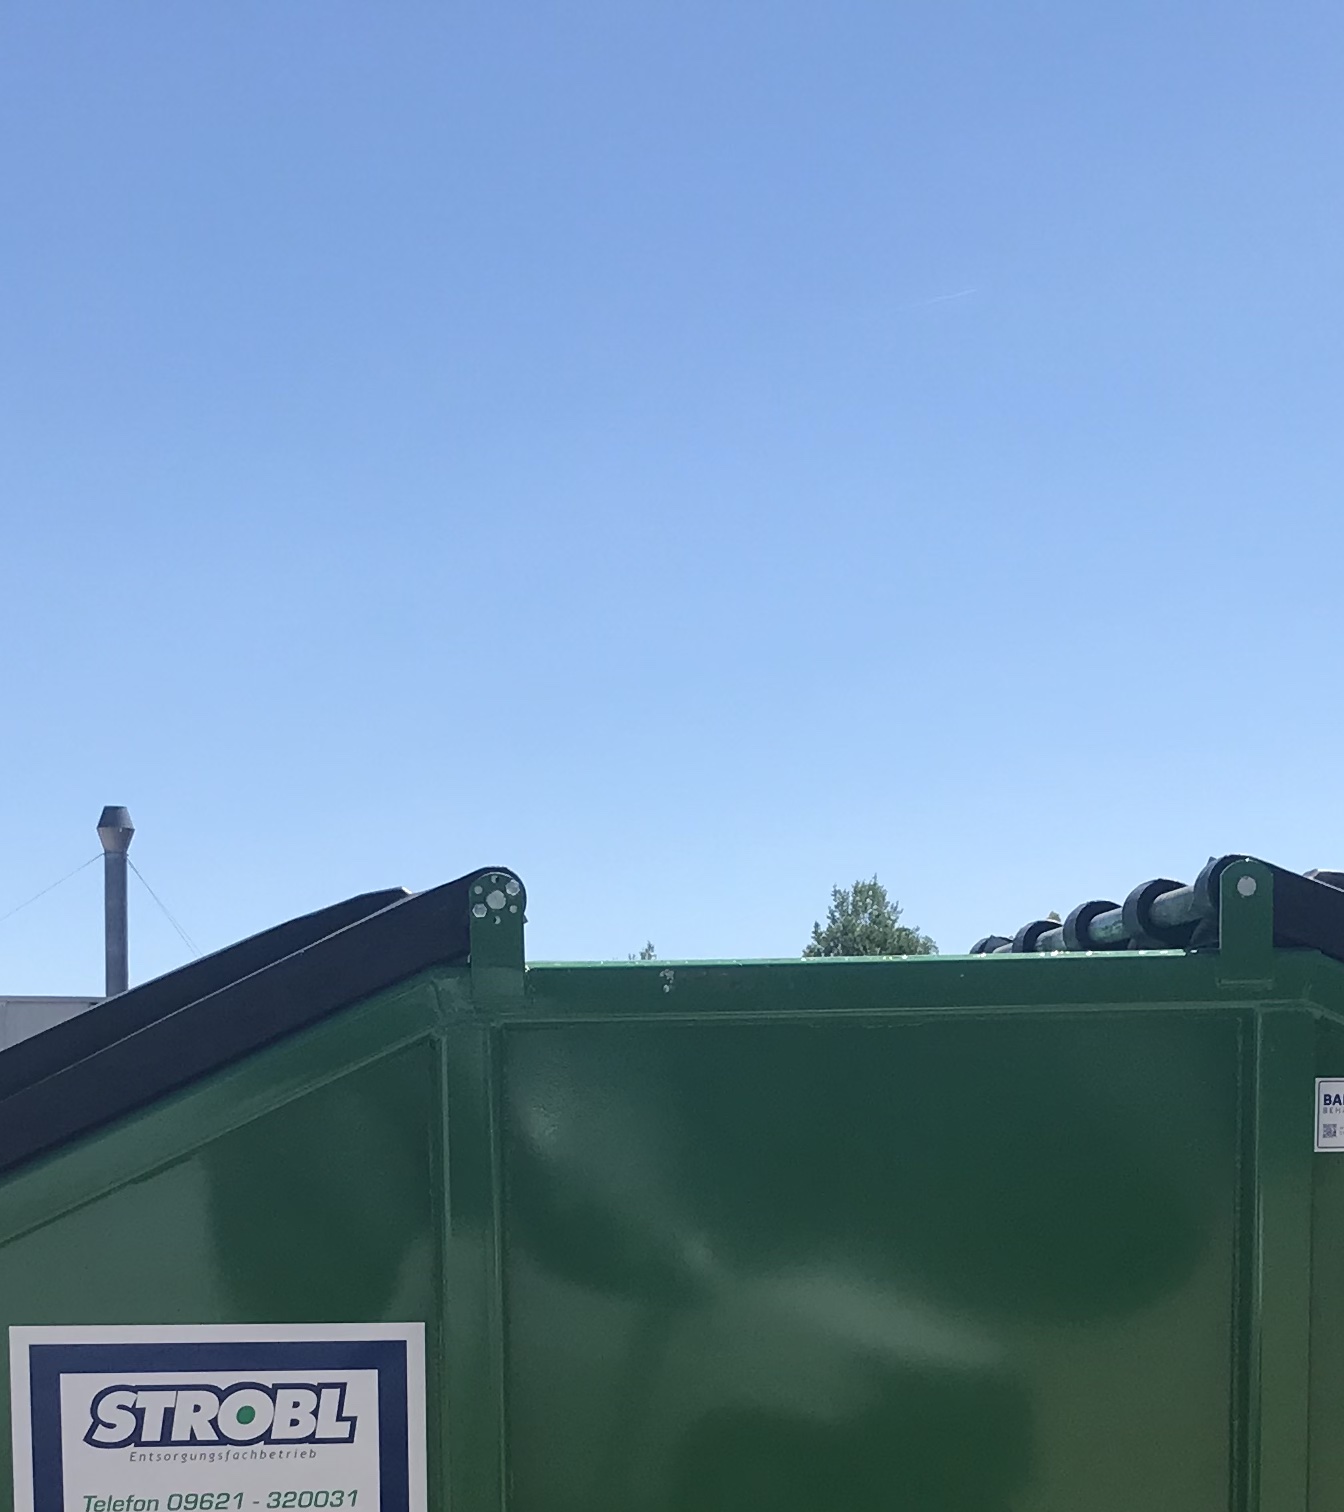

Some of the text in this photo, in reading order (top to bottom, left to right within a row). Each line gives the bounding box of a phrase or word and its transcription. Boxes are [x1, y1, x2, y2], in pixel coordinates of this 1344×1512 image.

[83, 1382, 358, 1449] STROBL
[129, 1449, 318, 1463] Entsorgungsfachbetrieb
[83, 1494, 159, 1512] Telefon
[166, 1491, 244, 1512] 09621
[266, 1489, 359, 1510] 320031
